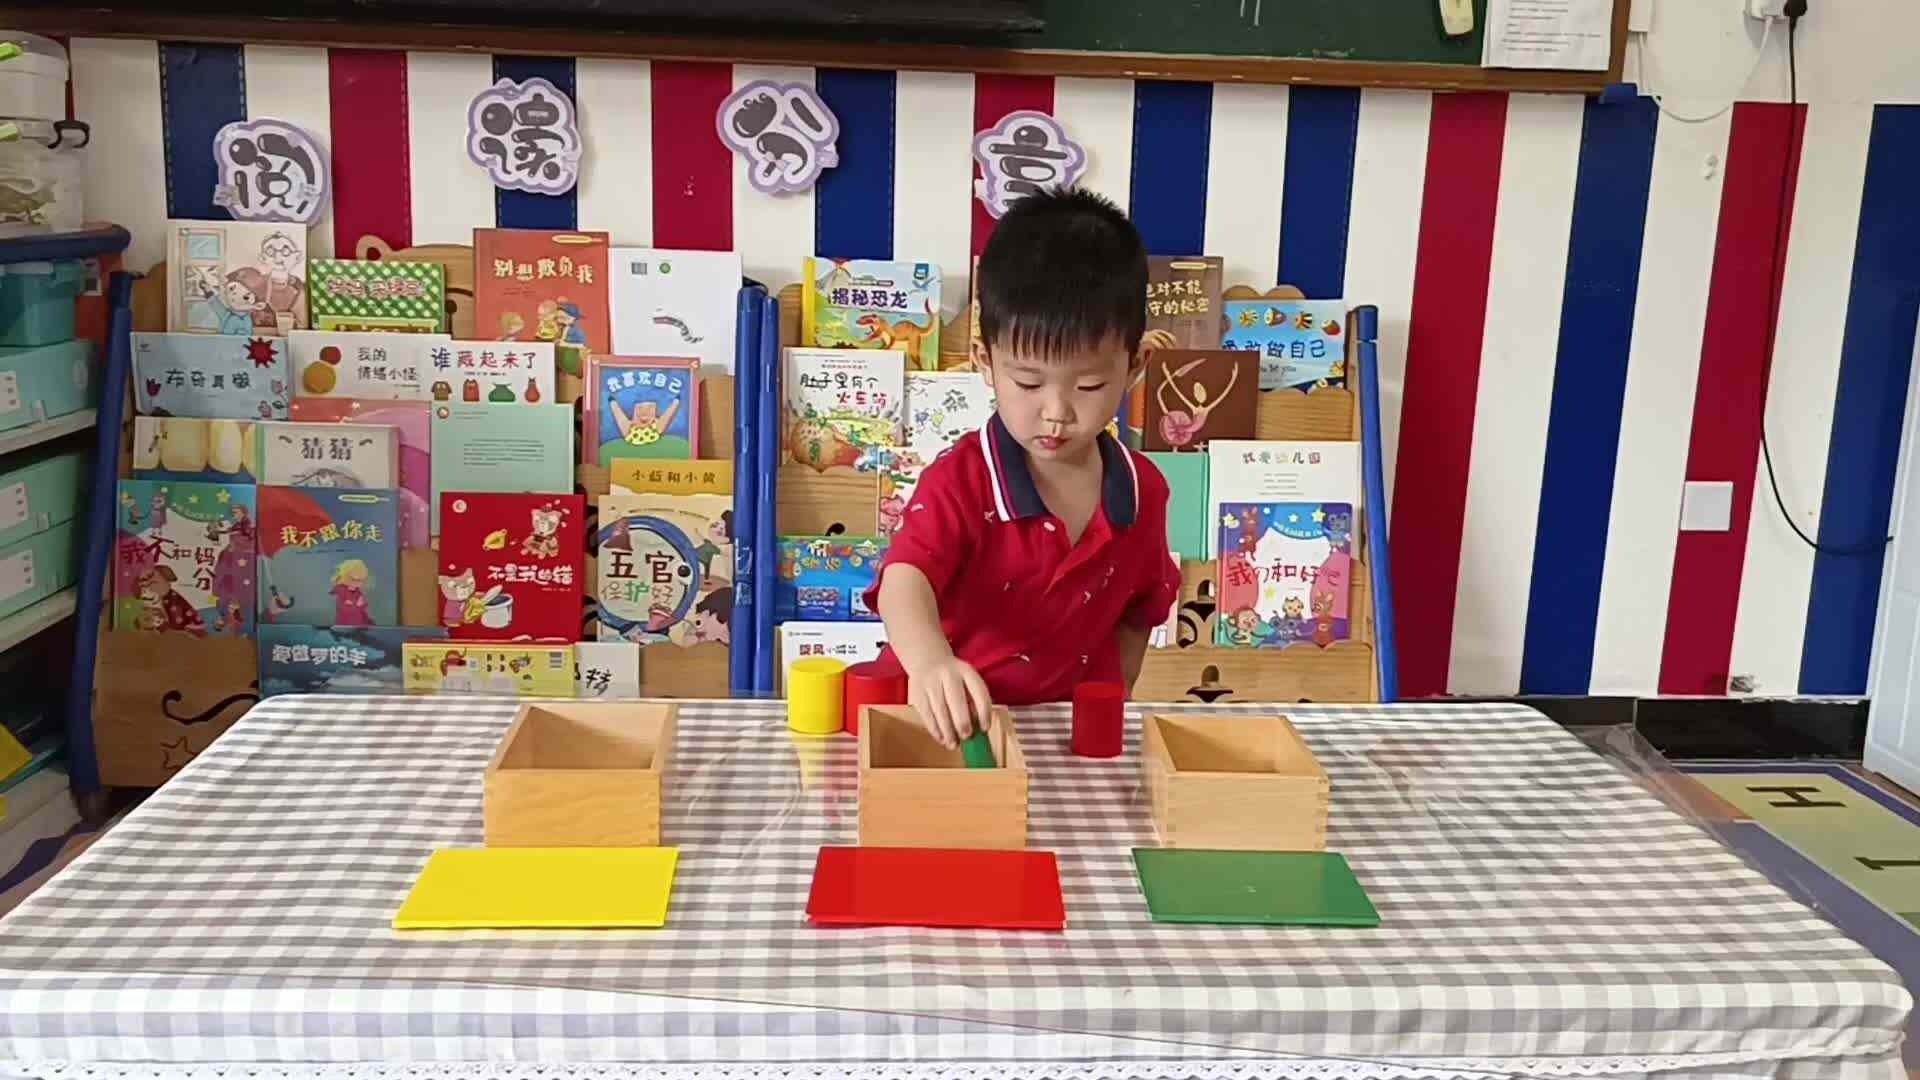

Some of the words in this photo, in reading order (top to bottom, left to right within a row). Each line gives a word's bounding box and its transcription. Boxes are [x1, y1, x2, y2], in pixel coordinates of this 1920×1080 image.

[479, 92, 566, 180] 读
[494, 255, 594, 284] 别想欺负我
[831, 287, 909, 309] 揭秘恐龙
[431, 347, 537, 372] 谁藏起来了
[607, 369, 683, 395] 我喜欢自己
[799, 371, 880, 391] 肚子里有个
[301, 437, 354, 461] 猜猜
[280, 519, 384, 549] 我不跟你走
[606, 550, 675, 584] 五官
[601, 581, 675, 606] 保护好
